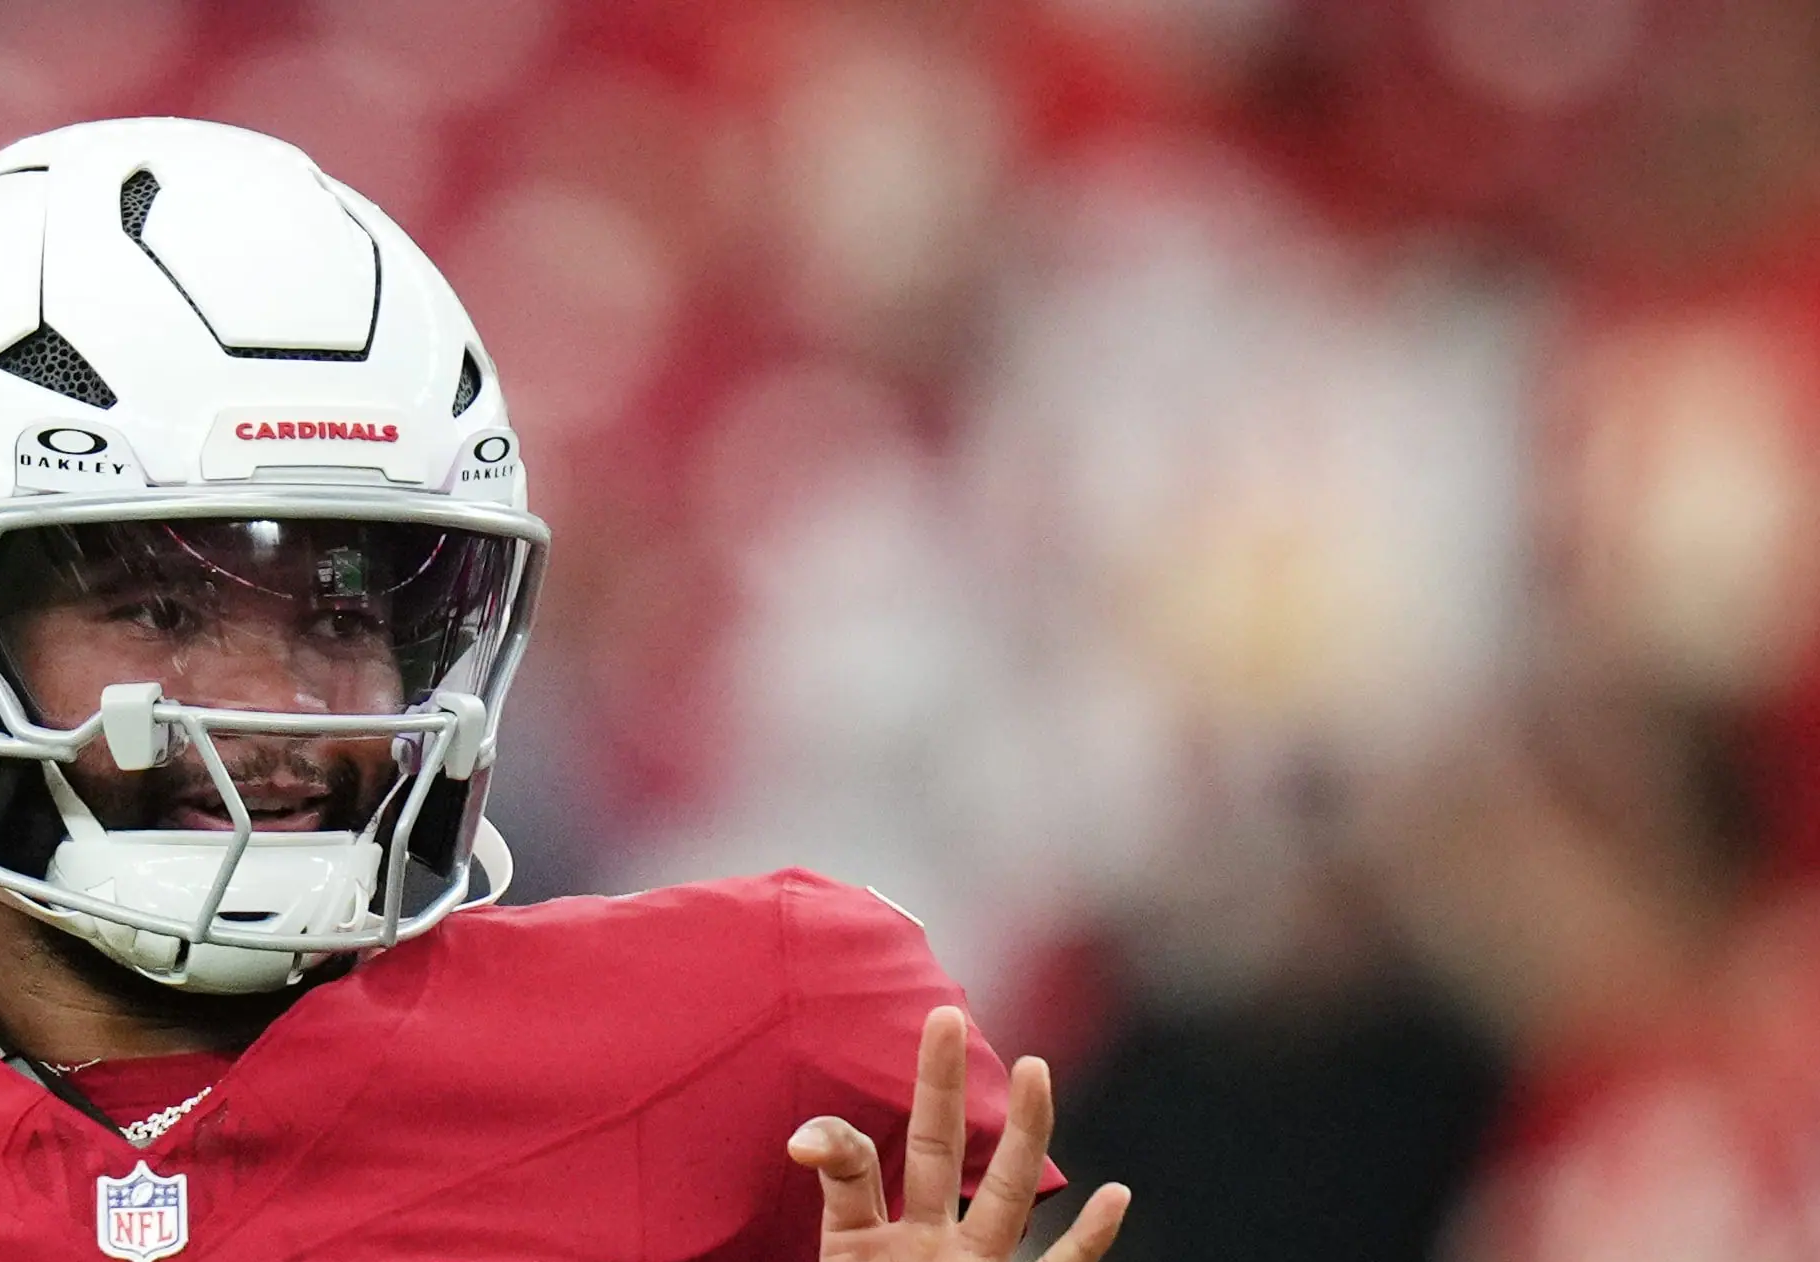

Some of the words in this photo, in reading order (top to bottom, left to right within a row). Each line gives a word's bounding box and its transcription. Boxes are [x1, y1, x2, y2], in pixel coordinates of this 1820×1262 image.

[235, 421, 399, 442] CARDINALS
[20, 454, 124, 475] OAKLEY
[115, 1211, 173, 1247] NFL
